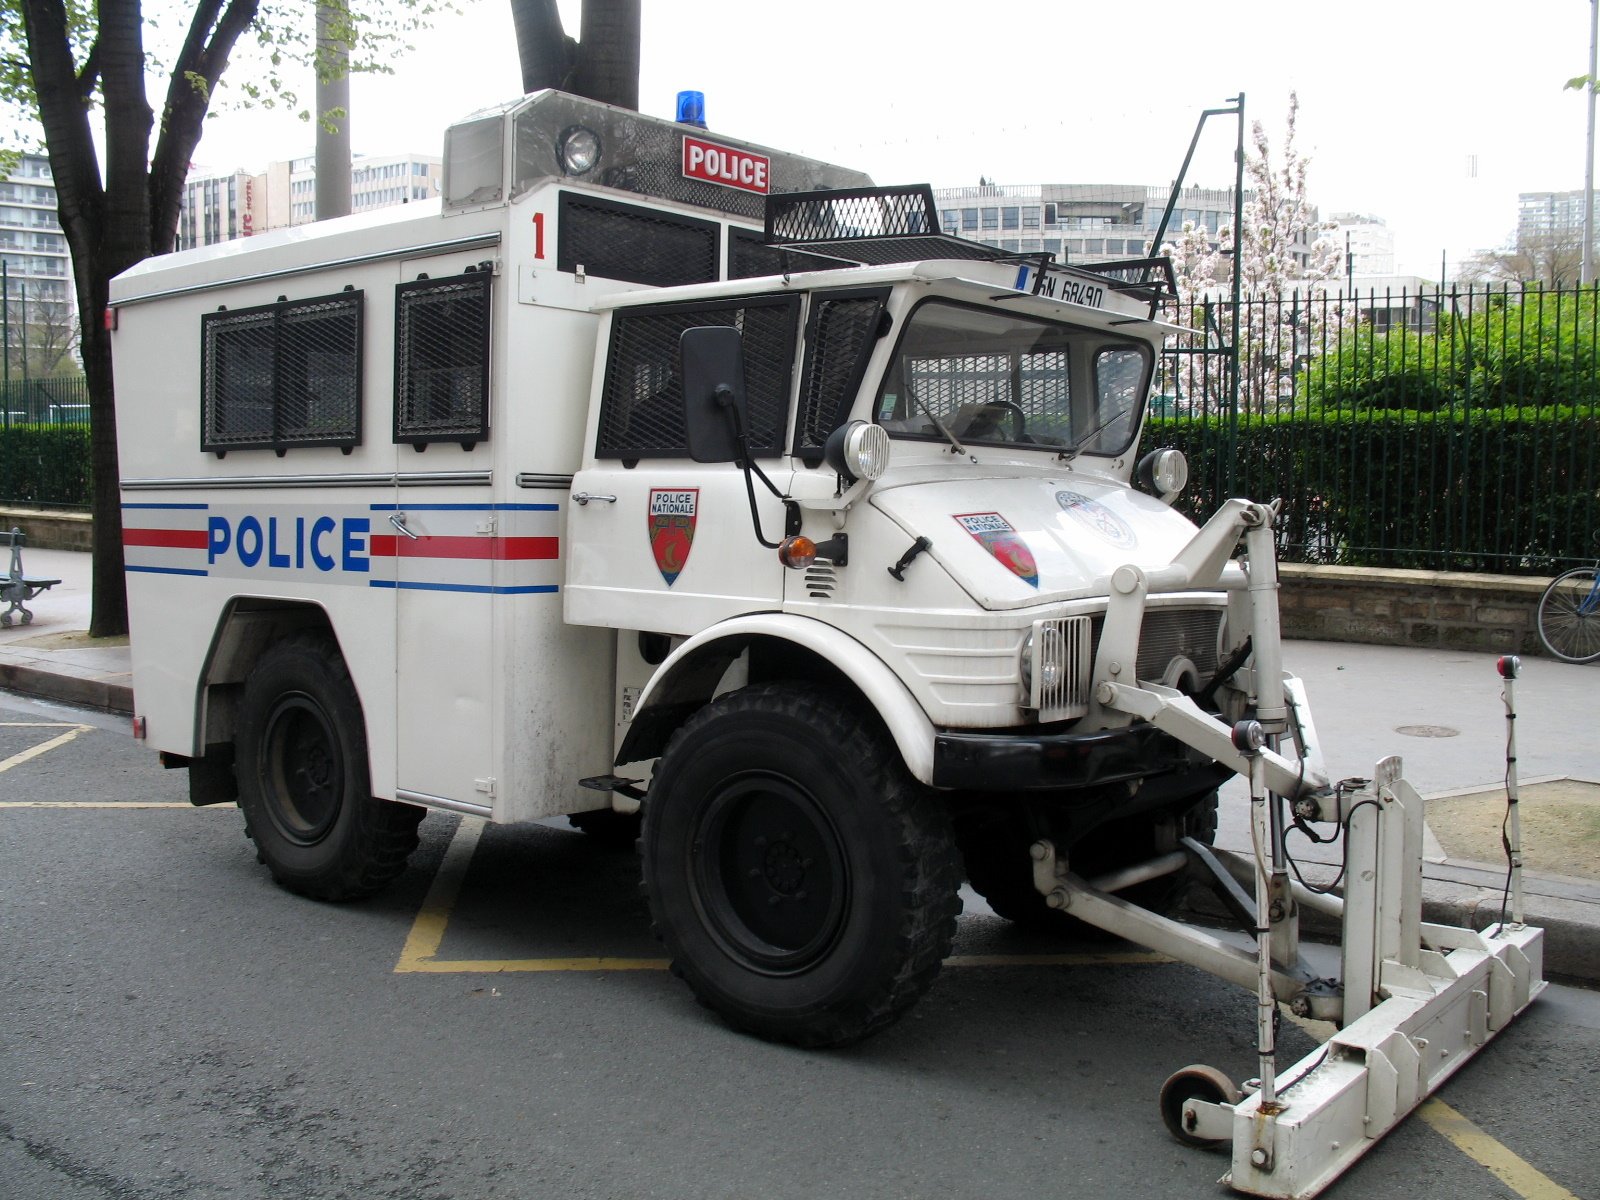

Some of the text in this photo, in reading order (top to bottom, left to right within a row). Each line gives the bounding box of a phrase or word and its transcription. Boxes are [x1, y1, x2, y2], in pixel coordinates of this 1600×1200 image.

[689, 145, 766, 188] POLICE
[532, 212, 545, 260] 1
[655, 494, 691, 503] POLICE
[652, 504, 694, 513] NATIONALE
[962, 515, 1000, 524] POLICE
[966, 522, 1010, 531] NATIONALE
[208, 515, 370, 572] POLICE
